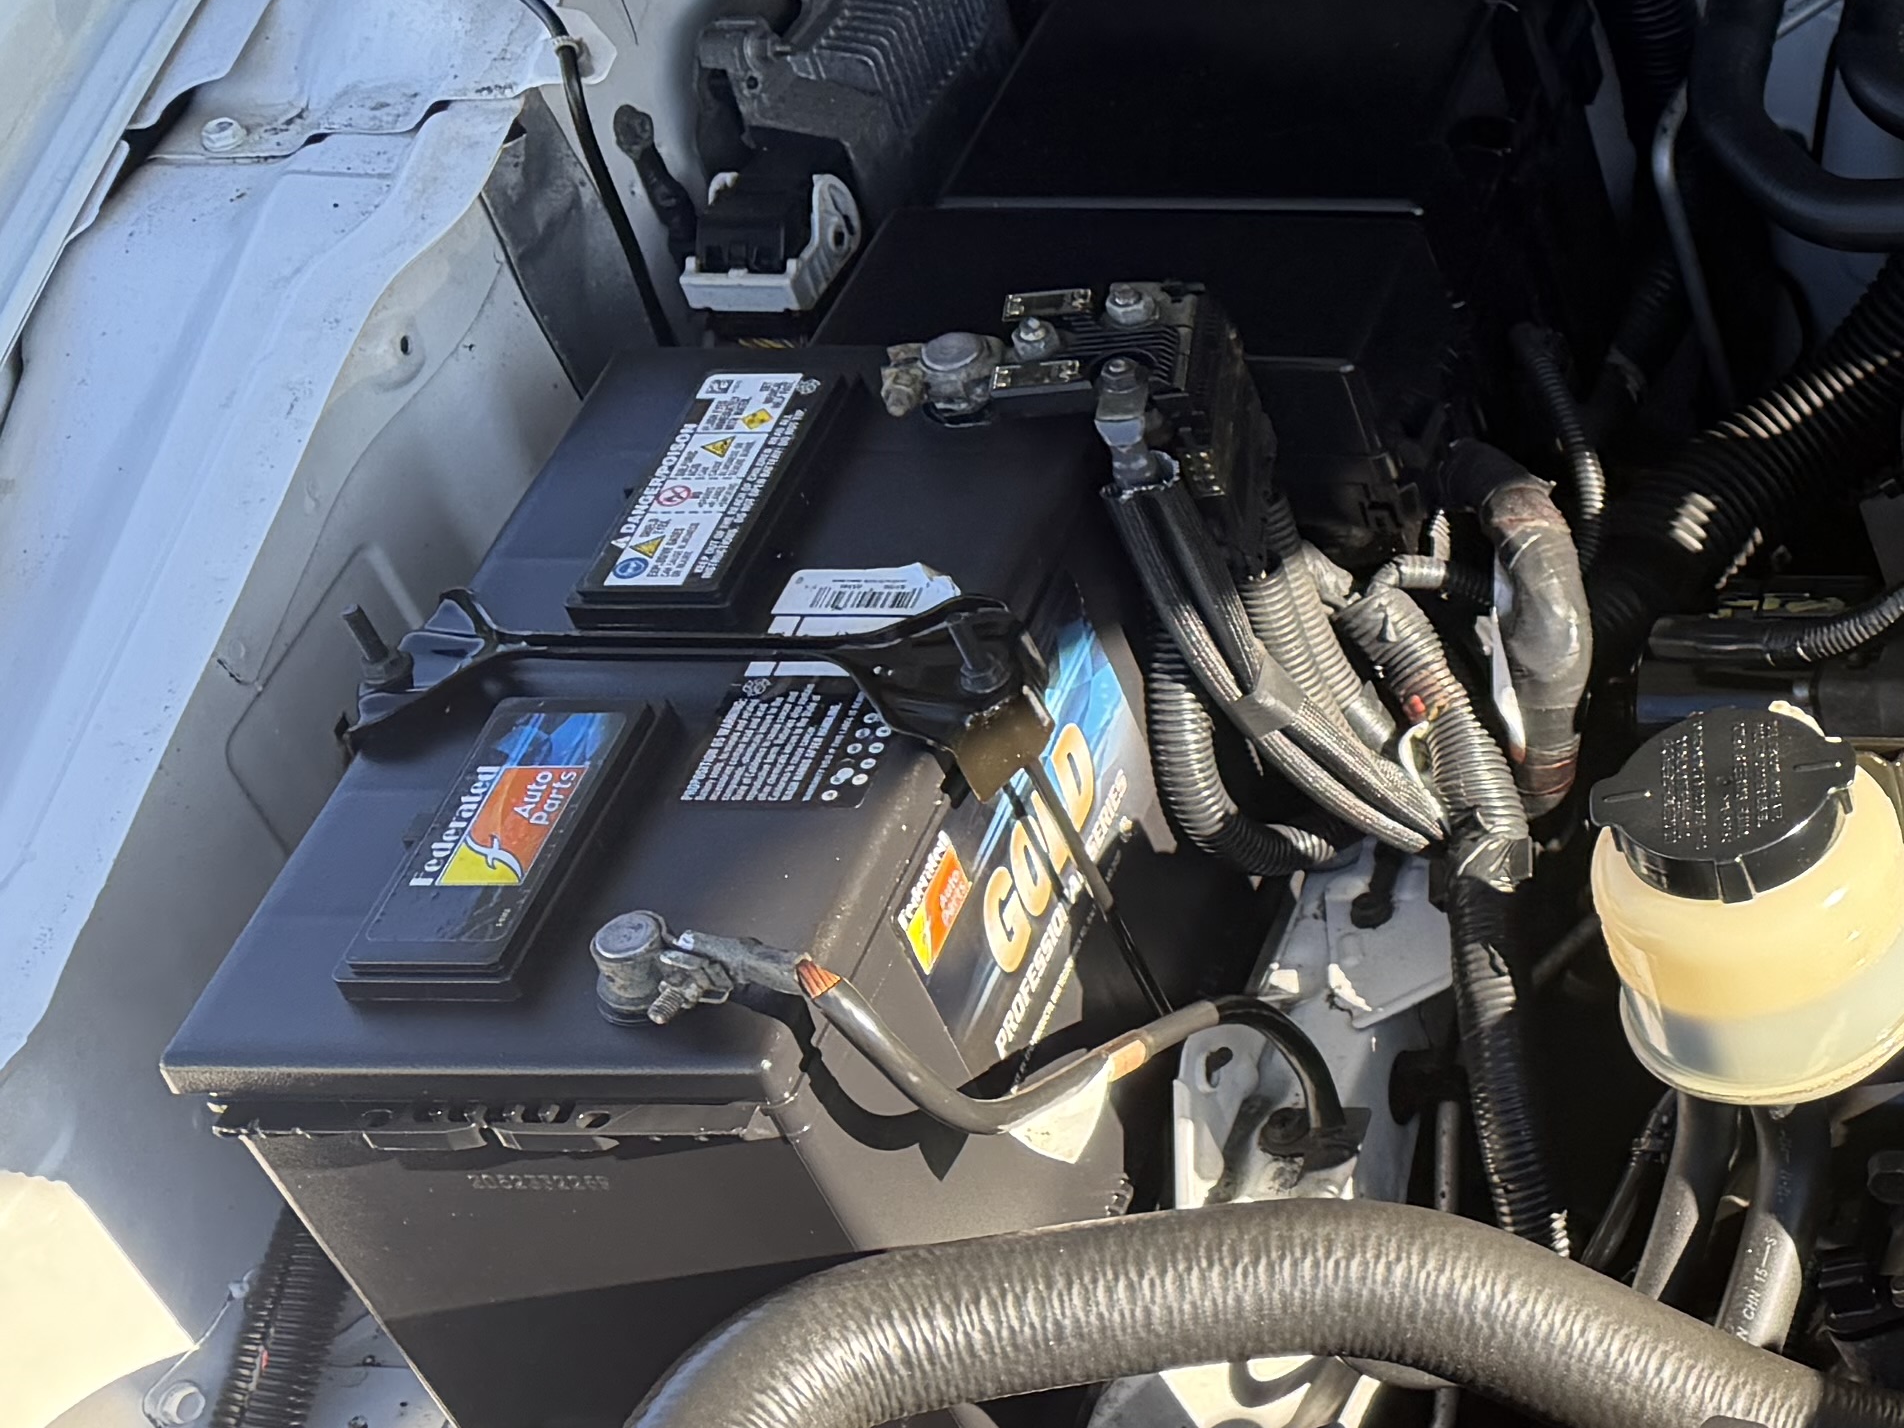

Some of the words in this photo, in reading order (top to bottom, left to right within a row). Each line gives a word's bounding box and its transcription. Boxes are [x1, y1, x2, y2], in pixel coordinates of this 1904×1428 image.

[625, 423, 698, 534] DANGER/POISON
[409, 766, 500, 886] Federated
[513, 771, 553, 819] Auto
[529, 771, 577, 825] Parts
[1085, 770, 1127, 862] SERIES
[983, 722, 1095, 973] GOLD
